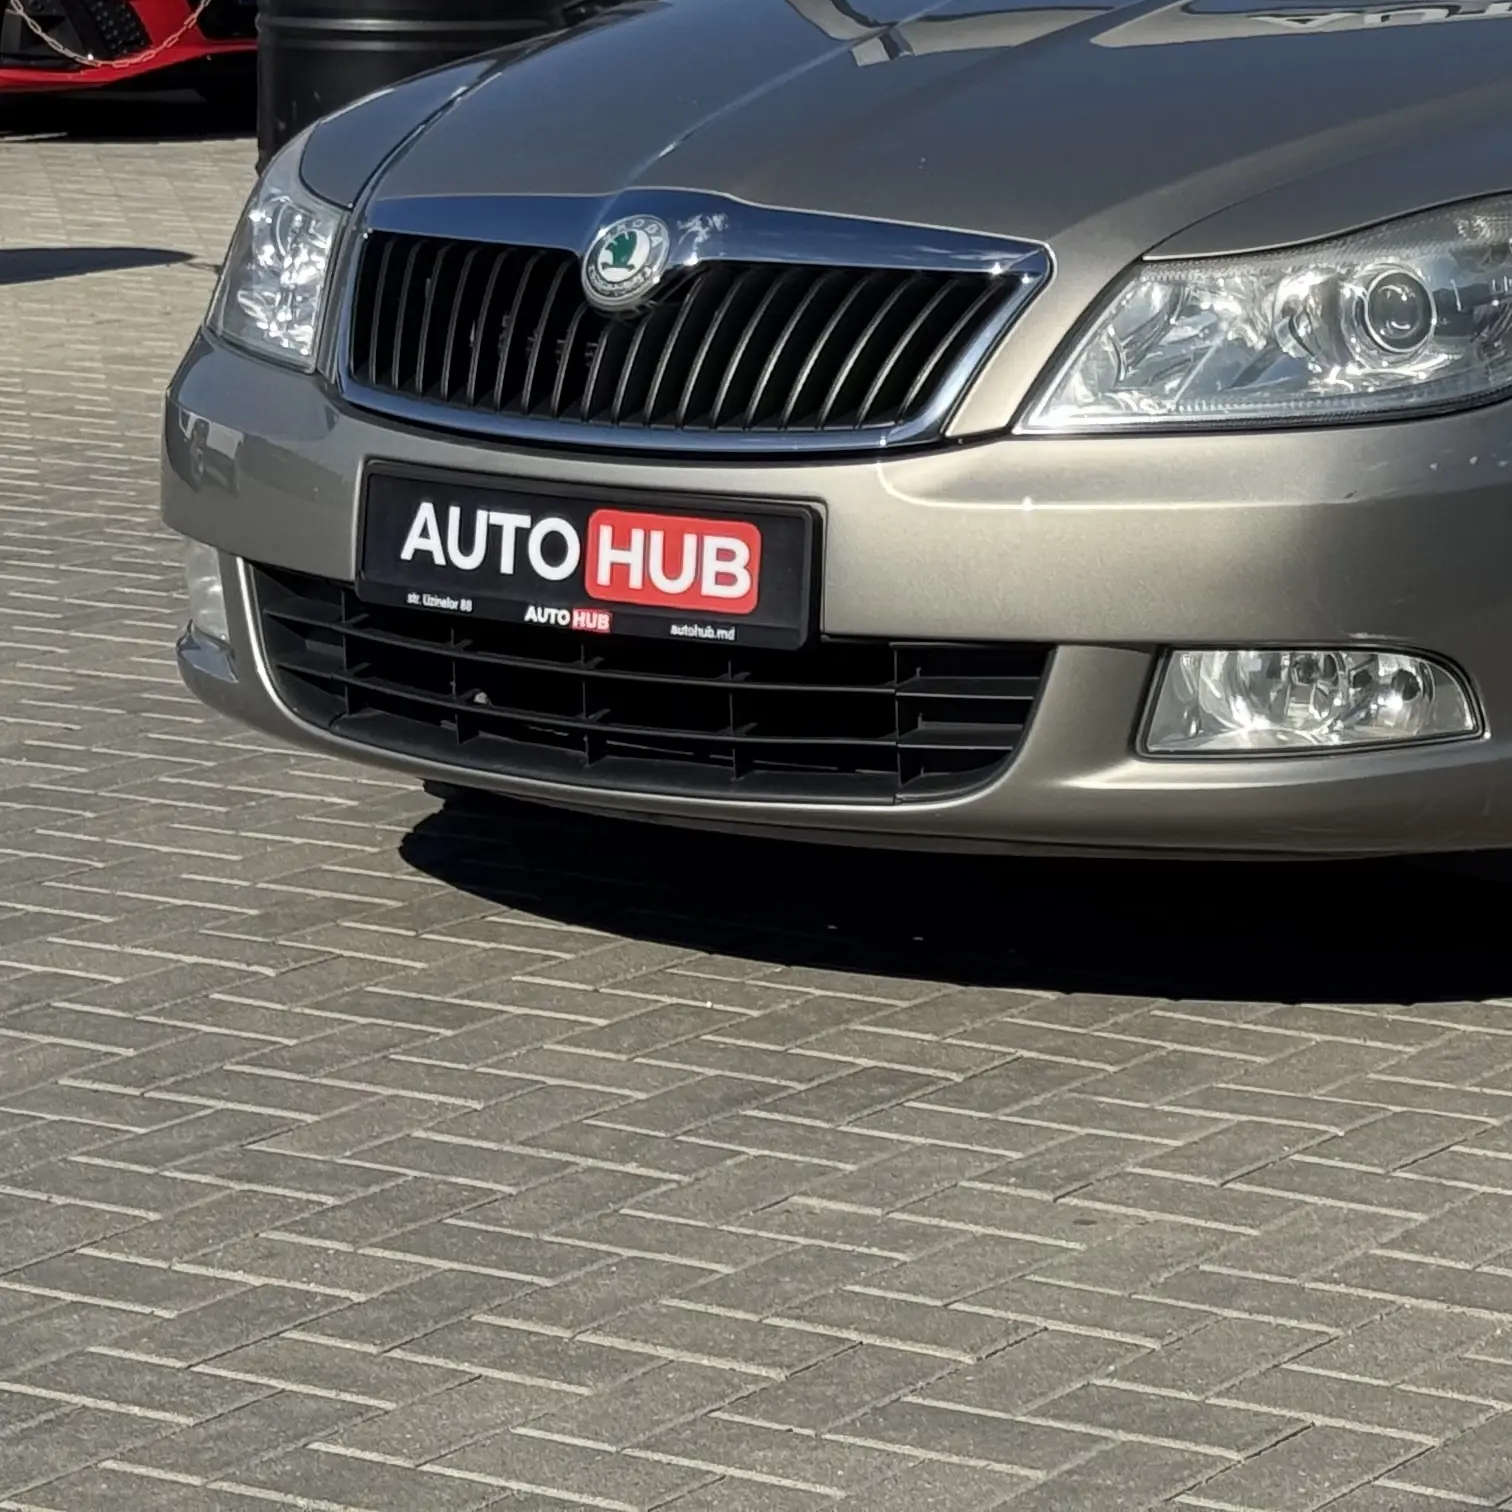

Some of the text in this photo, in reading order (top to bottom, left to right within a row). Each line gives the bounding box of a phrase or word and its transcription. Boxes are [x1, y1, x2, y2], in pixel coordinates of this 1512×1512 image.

[400, 502, 751, 598] AUTO HUB
[524, 605, 610, 630] AUTO HUB
